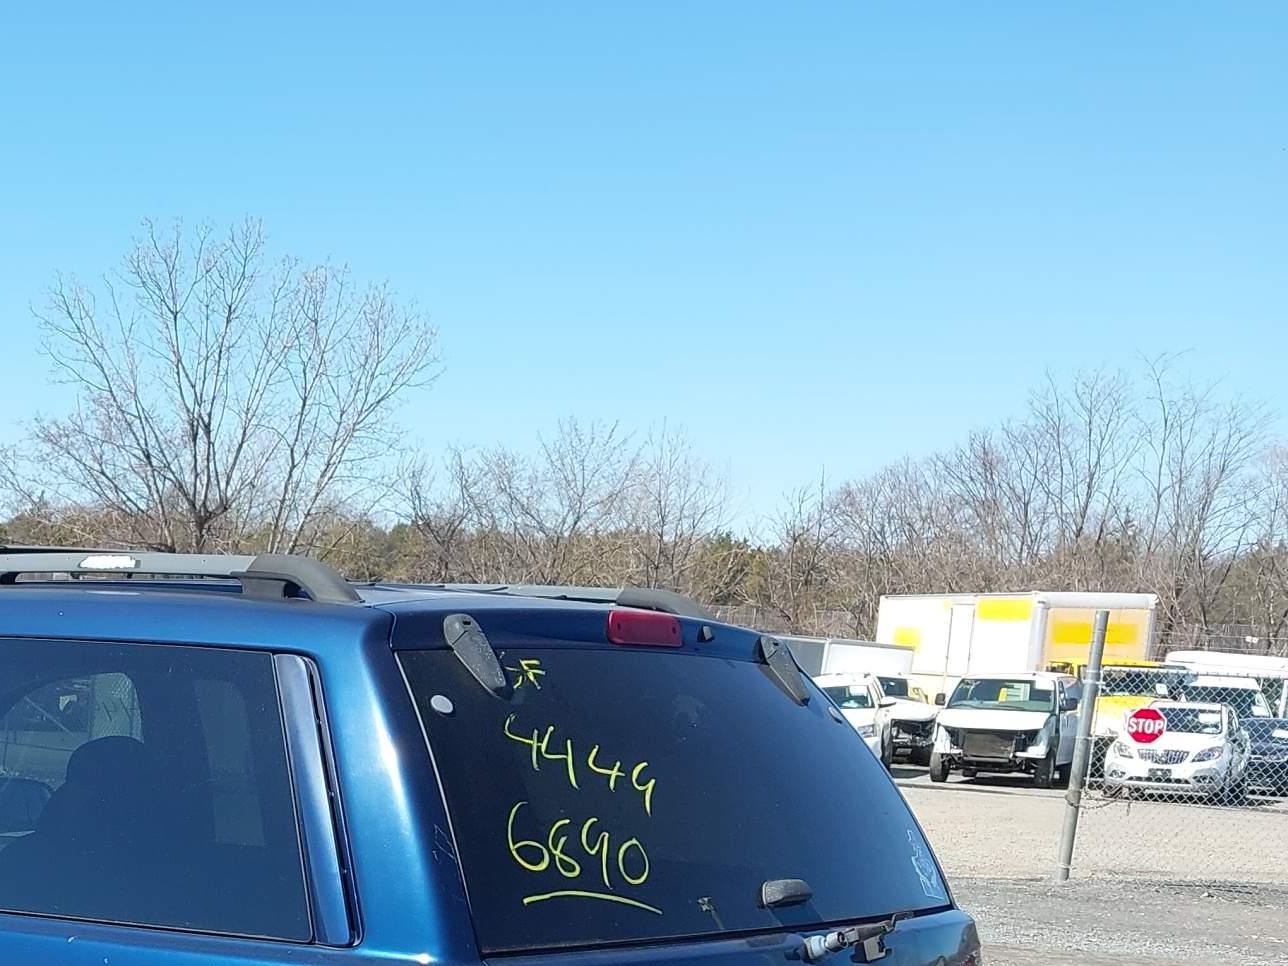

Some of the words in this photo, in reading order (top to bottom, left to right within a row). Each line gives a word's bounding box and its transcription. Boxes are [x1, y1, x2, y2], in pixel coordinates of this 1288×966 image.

[503, 713, 656, 817] 4449
[1128, 717, 1164, 735] STOP
[507, 800, 650, 890] 6890
